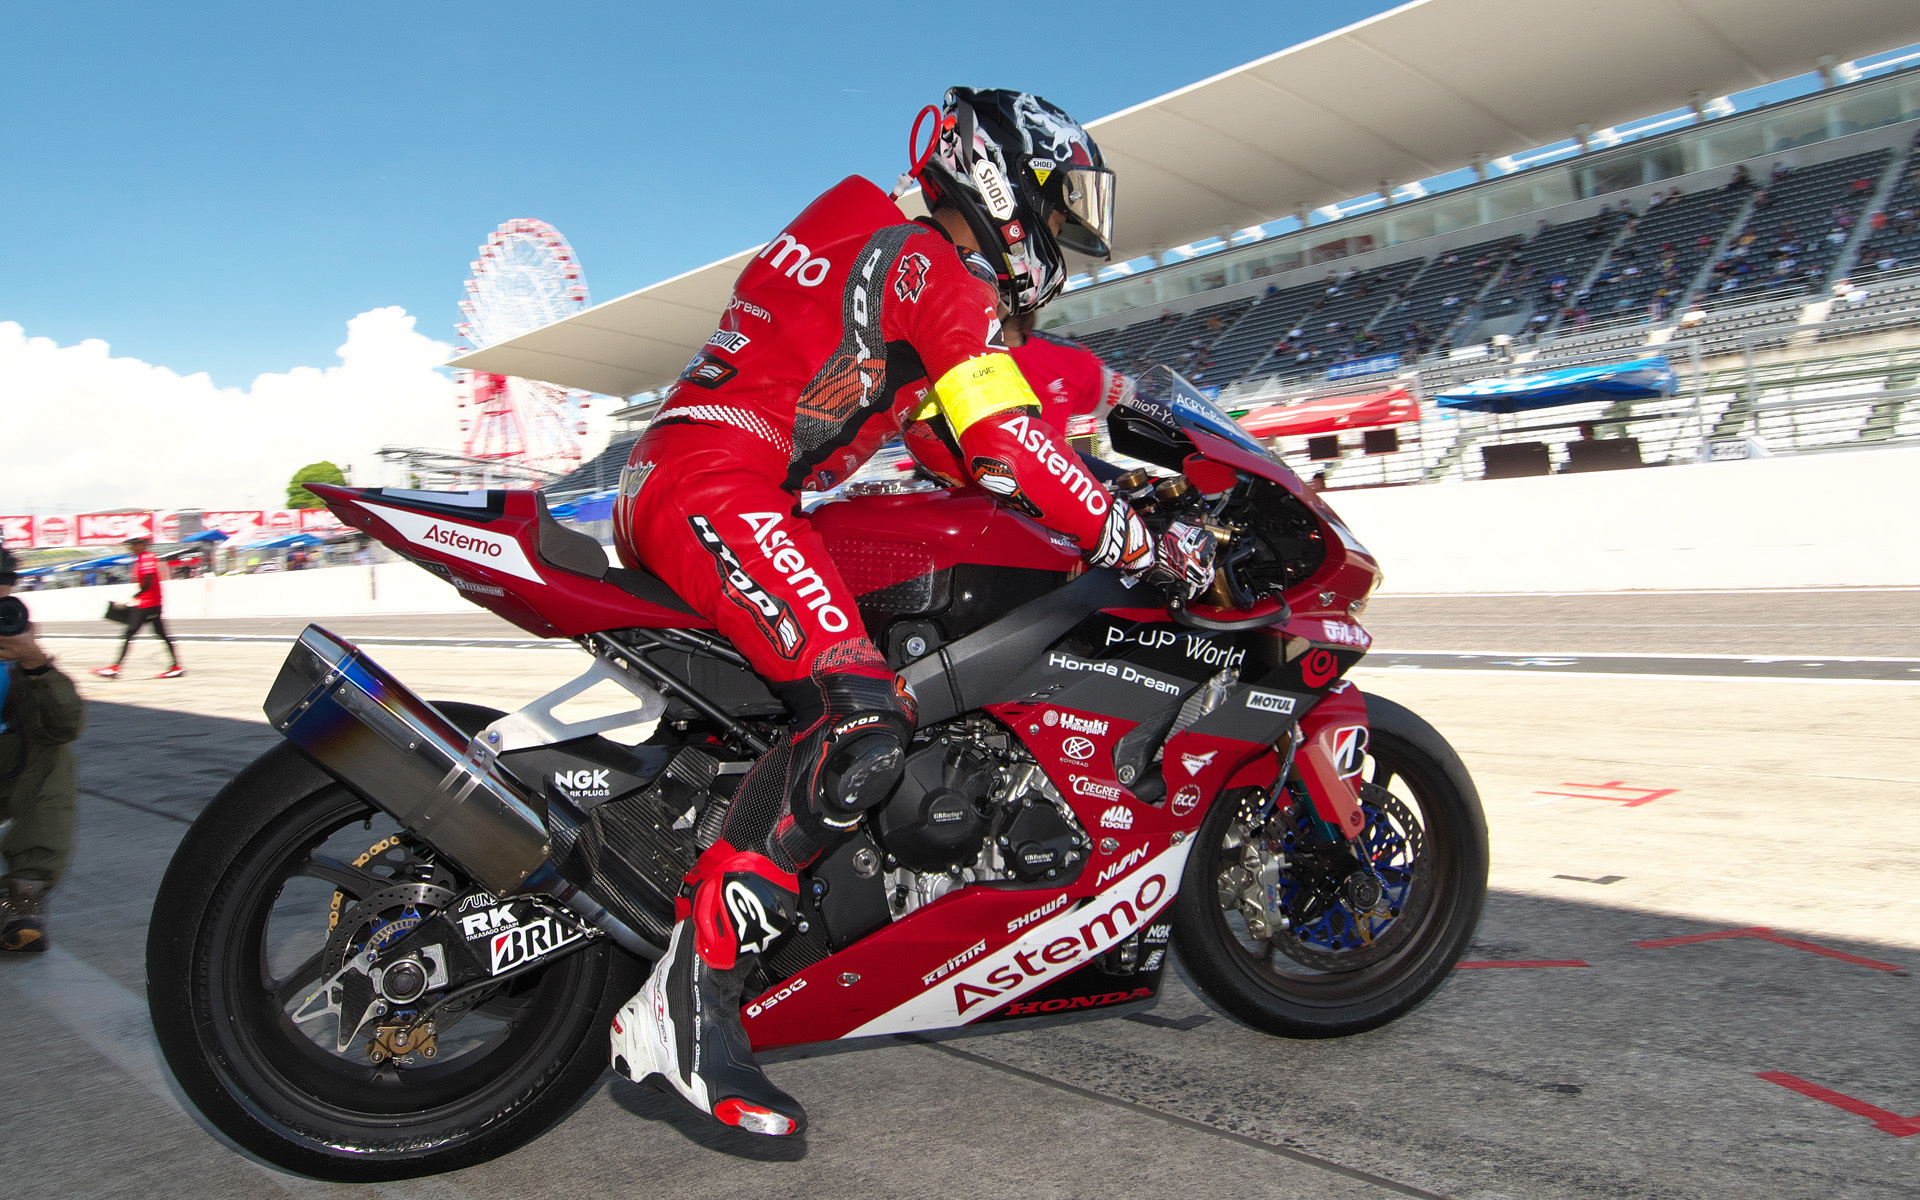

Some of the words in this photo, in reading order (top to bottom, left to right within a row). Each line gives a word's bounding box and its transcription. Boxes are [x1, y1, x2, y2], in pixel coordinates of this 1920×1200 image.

[1033, 161, 1054, 169] SHOEI
[979, 168, 1009, 212] SHOEI
[972, 366, 995, 379] EWC
[999, 415, 1108, 516] Astemo
[422, 524, 502, 557] Astemo
[693, 516, 779, 617] HYOD
[738, 511, 849, 633] Astemo
[1105, 626, 1176, 649] P-UP
[1186, 634, 1247, 668] World
[1049, 653, 1118, 676] Honda
[1122, 668, 1181, 697] Dream
[1250, 695, 1292, 711] MOTUL
[837, 716, 879, 734] HYOD
[1060, 712, 1109, 731] Usuki
[555, 769, 610, 790] NGK
[1083, 782, 1121, 799] DEGREE
[583, 789, 610, 797] PLUGS
[1100, 820, 1132, 830] TOOLS
[1101, 805, 1134, 824] MAC
[461, 903, 518, 937] RK
[1007, 893, 1068, 934] SHOWA
[466, 928, 499, 941] TAKASAGO
[500, 921, 519, 931] CHAIN
[1146, 923, 1172, 938] NGK
[952, 874, 1166, 1016] Astemo
[922, 938, 986, 986] KEIHIN
[1004, 986, 1154, 1017] HONDA
